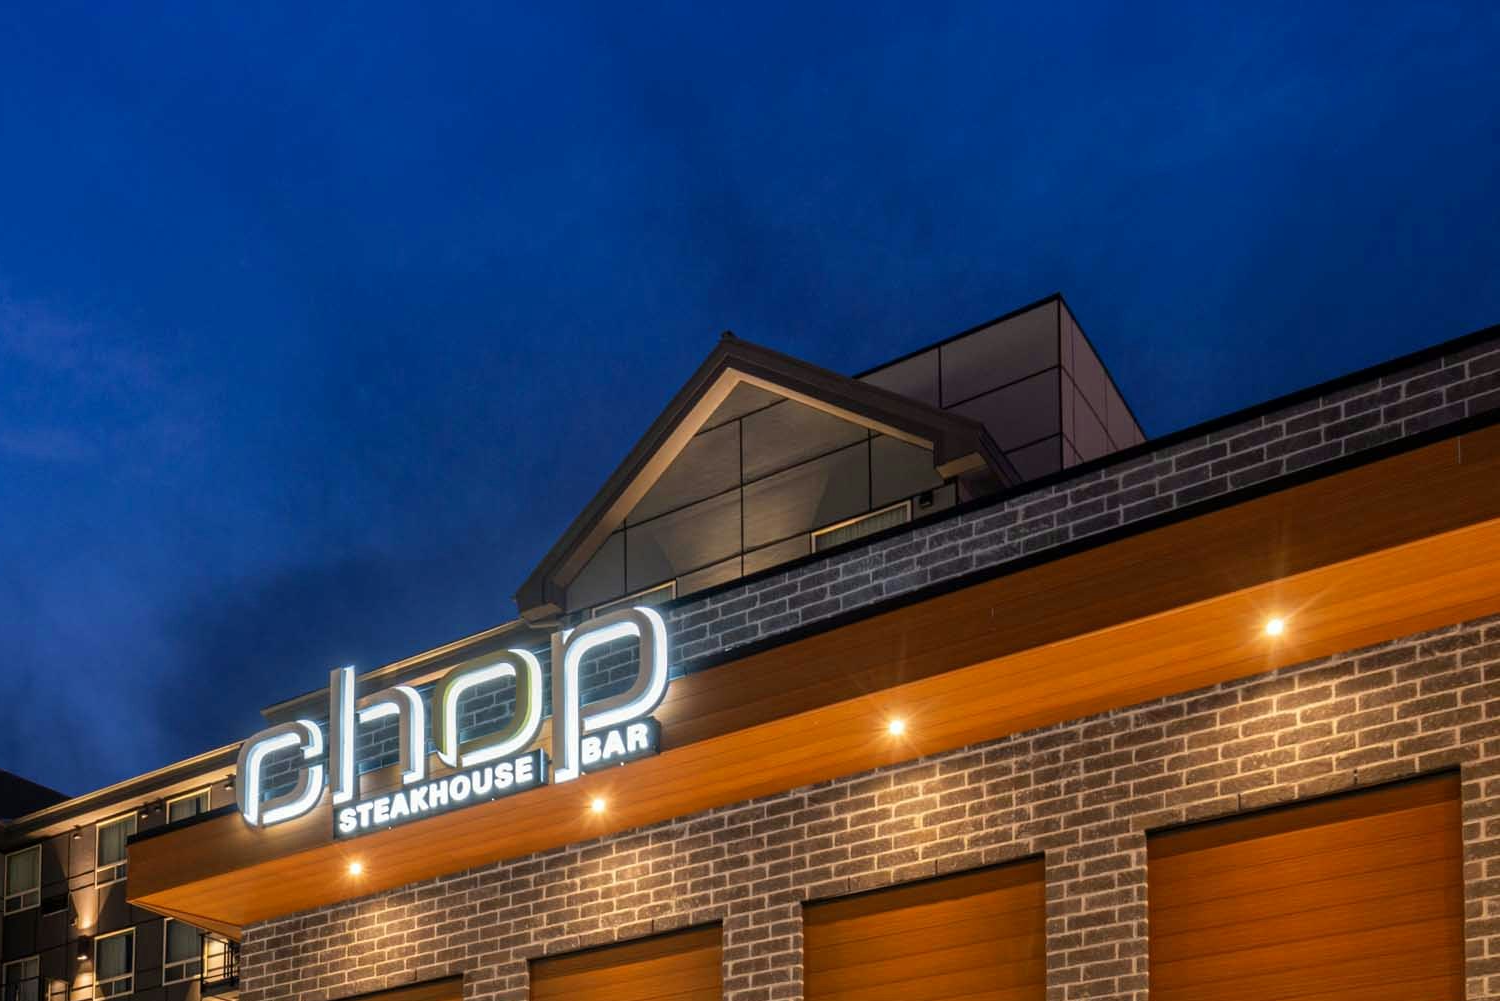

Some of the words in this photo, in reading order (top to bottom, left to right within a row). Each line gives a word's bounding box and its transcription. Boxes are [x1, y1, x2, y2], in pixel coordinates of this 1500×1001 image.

[238, 606, 669, 827] chop
[581, 722, 649, 766] BAR
[338, 756, 534, 833] STEAKHOUSE
